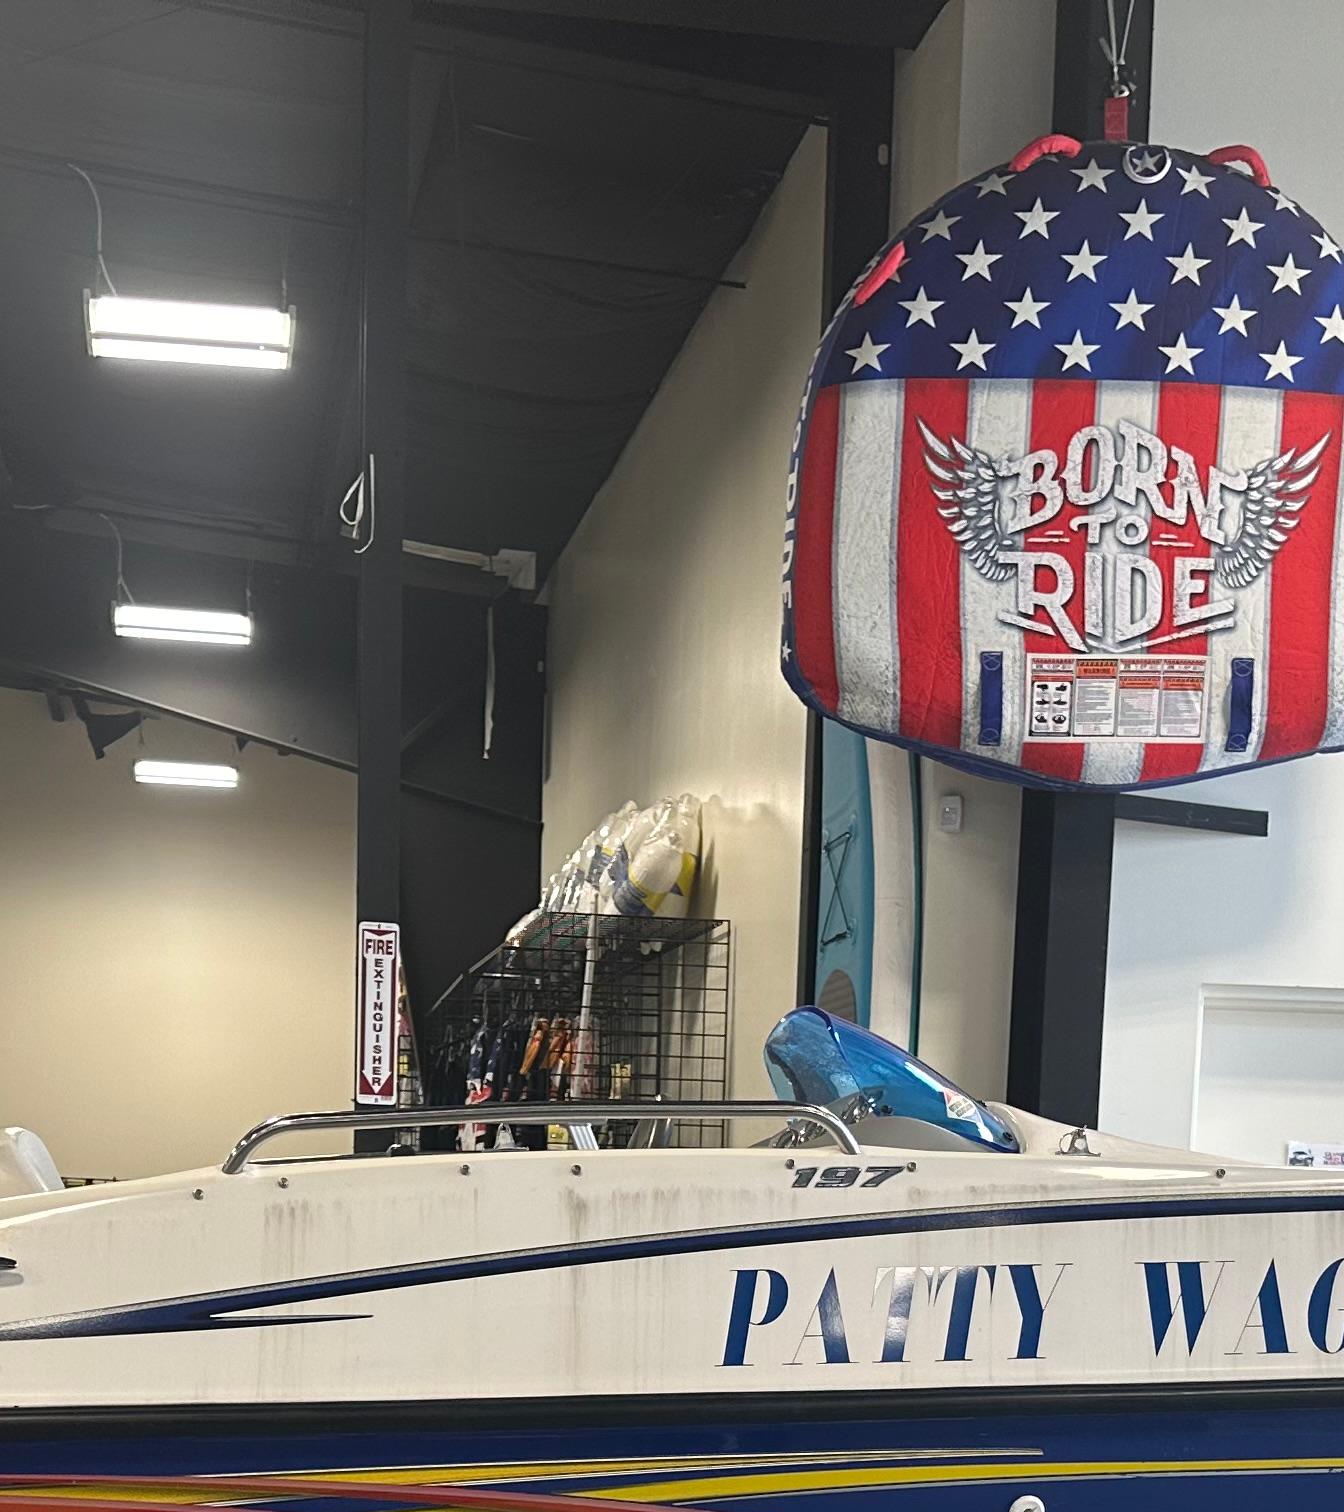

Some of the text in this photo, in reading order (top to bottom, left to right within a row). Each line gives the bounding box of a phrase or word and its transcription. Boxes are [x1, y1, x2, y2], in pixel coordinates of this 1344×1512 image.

[995, 419, 1249, 545] BORN
[1069, 506, 1149, 545] TO
[996, 551, 1235, 653] RIDE
[365, 938, 394, 956] FIRE
[372, 958, 385, 1087] EXTINGUISHER
[791, 1166, 906, 1188] 197
[713, 1262, 1074, 1367] PATTY
